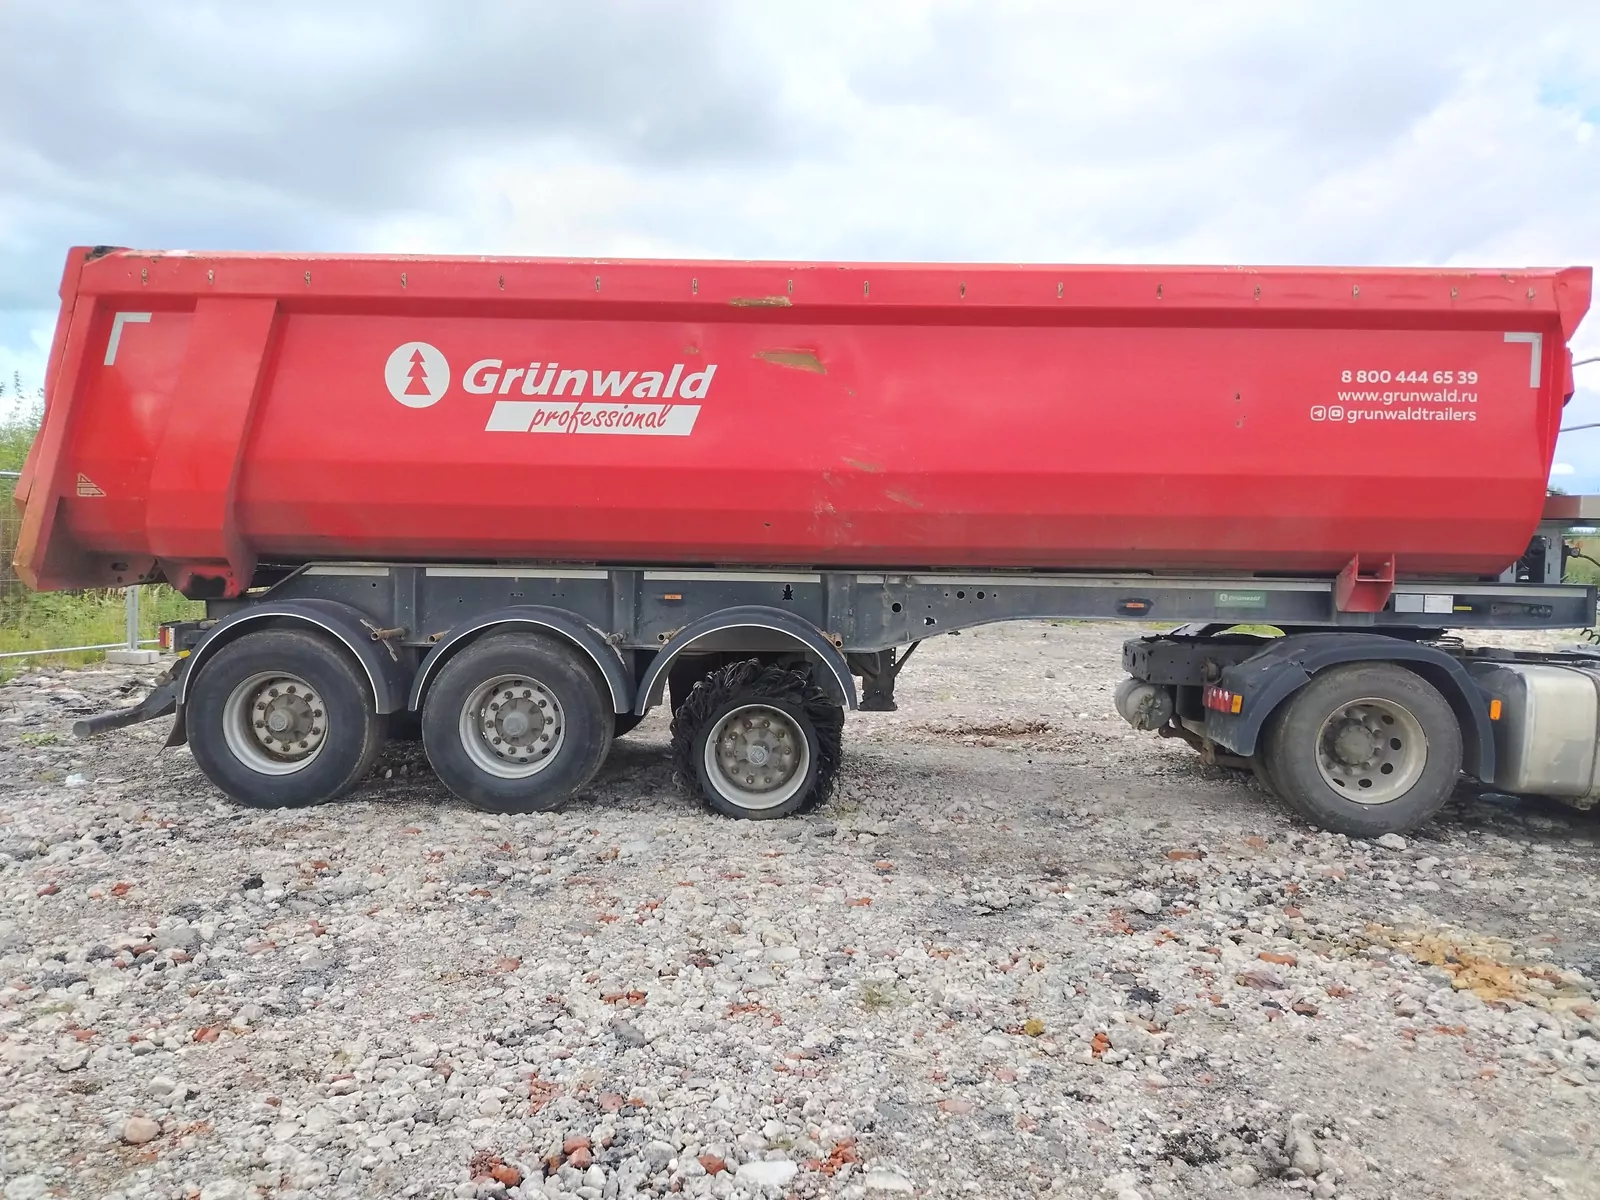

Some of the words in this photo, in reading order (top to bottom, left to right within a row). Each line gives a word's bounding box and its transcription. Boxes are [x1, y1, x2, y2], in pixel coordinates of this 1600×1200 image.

[462, 359, 717, 399] Grünwald
[1341, 370, 1352, 383] 8
[1356, 370, 1391, 384] 800
[1395, 371, 1428, 384] 444
[1432, 371, 1453, 384] 65
[1457, 371, 1478, 384] 39
[1337, 389, 1478, 405] www.grunwald.ru
[527, 404, 674, 433] professional
[1347, 407, 1477, 423] grunwaldtrailers
